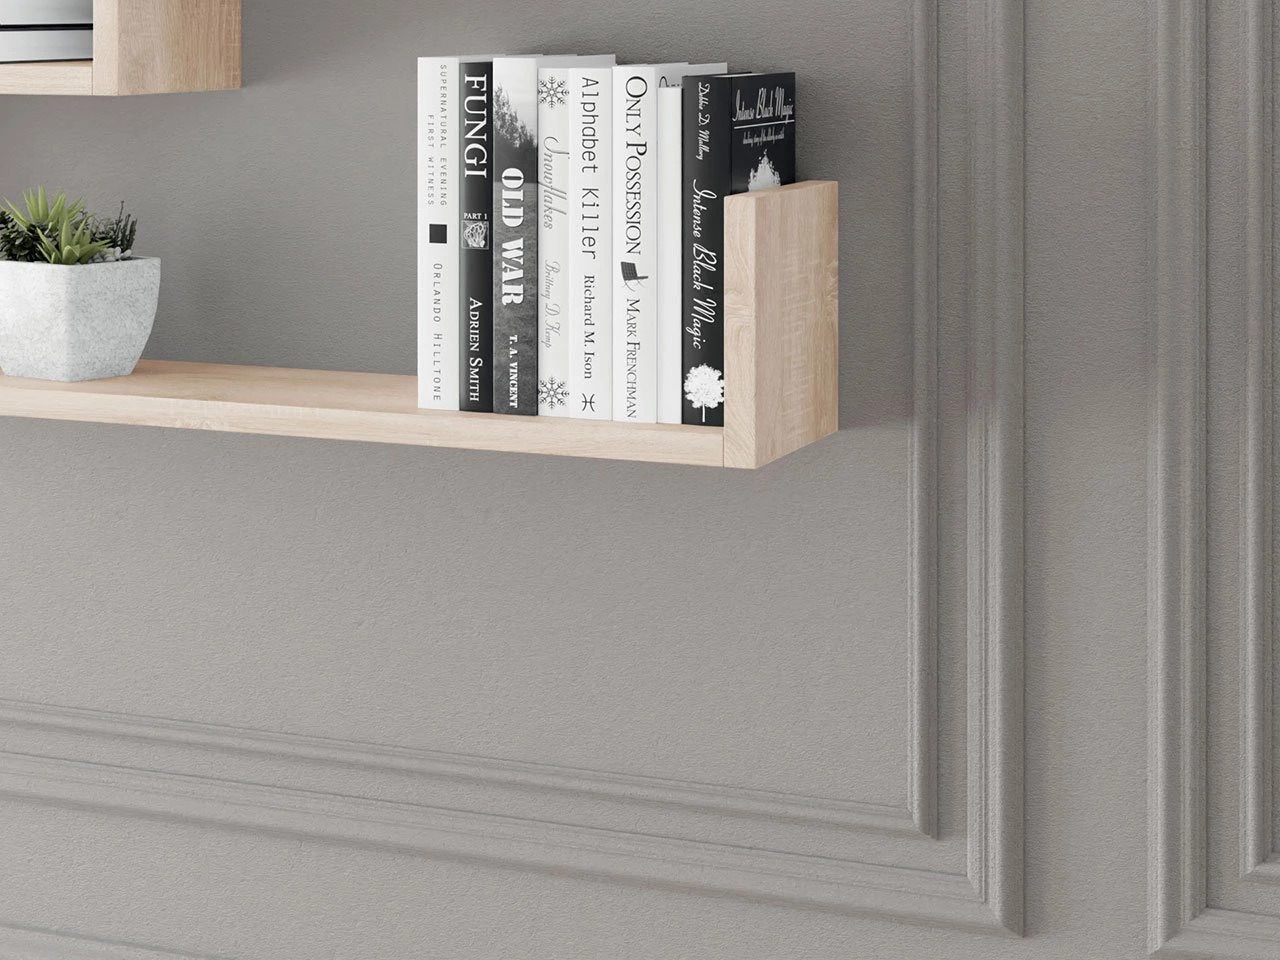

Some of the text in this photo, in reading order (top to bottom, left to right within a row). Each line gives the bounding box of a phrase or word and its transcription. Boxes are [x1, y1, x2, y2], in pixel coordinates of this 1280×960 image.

[464, 74, 487, 178] FUNGI
[581, 77, 599, 259] Alphabet Killer
[626, 76, 647, 255] ONLY POSSESSION
[696, 82, 710, 160] Debbie D. Mallory
[502, 168, 524, 305] OLD WAR
[538, 137, 570, 229] Snowflakes
[686, 179, 717, 349] Intense Black Magic
[433, 263, 443, 401] ORLANDO HILLTONE
[469, 298, 483, 402] ADRIEN SMITH
[509, 335, 518, 408] T. A. VINCENT
[584, 275, 595, 379] Richard M. Ison
[626, 298, 640, 418] MARK FRENCHMAN
